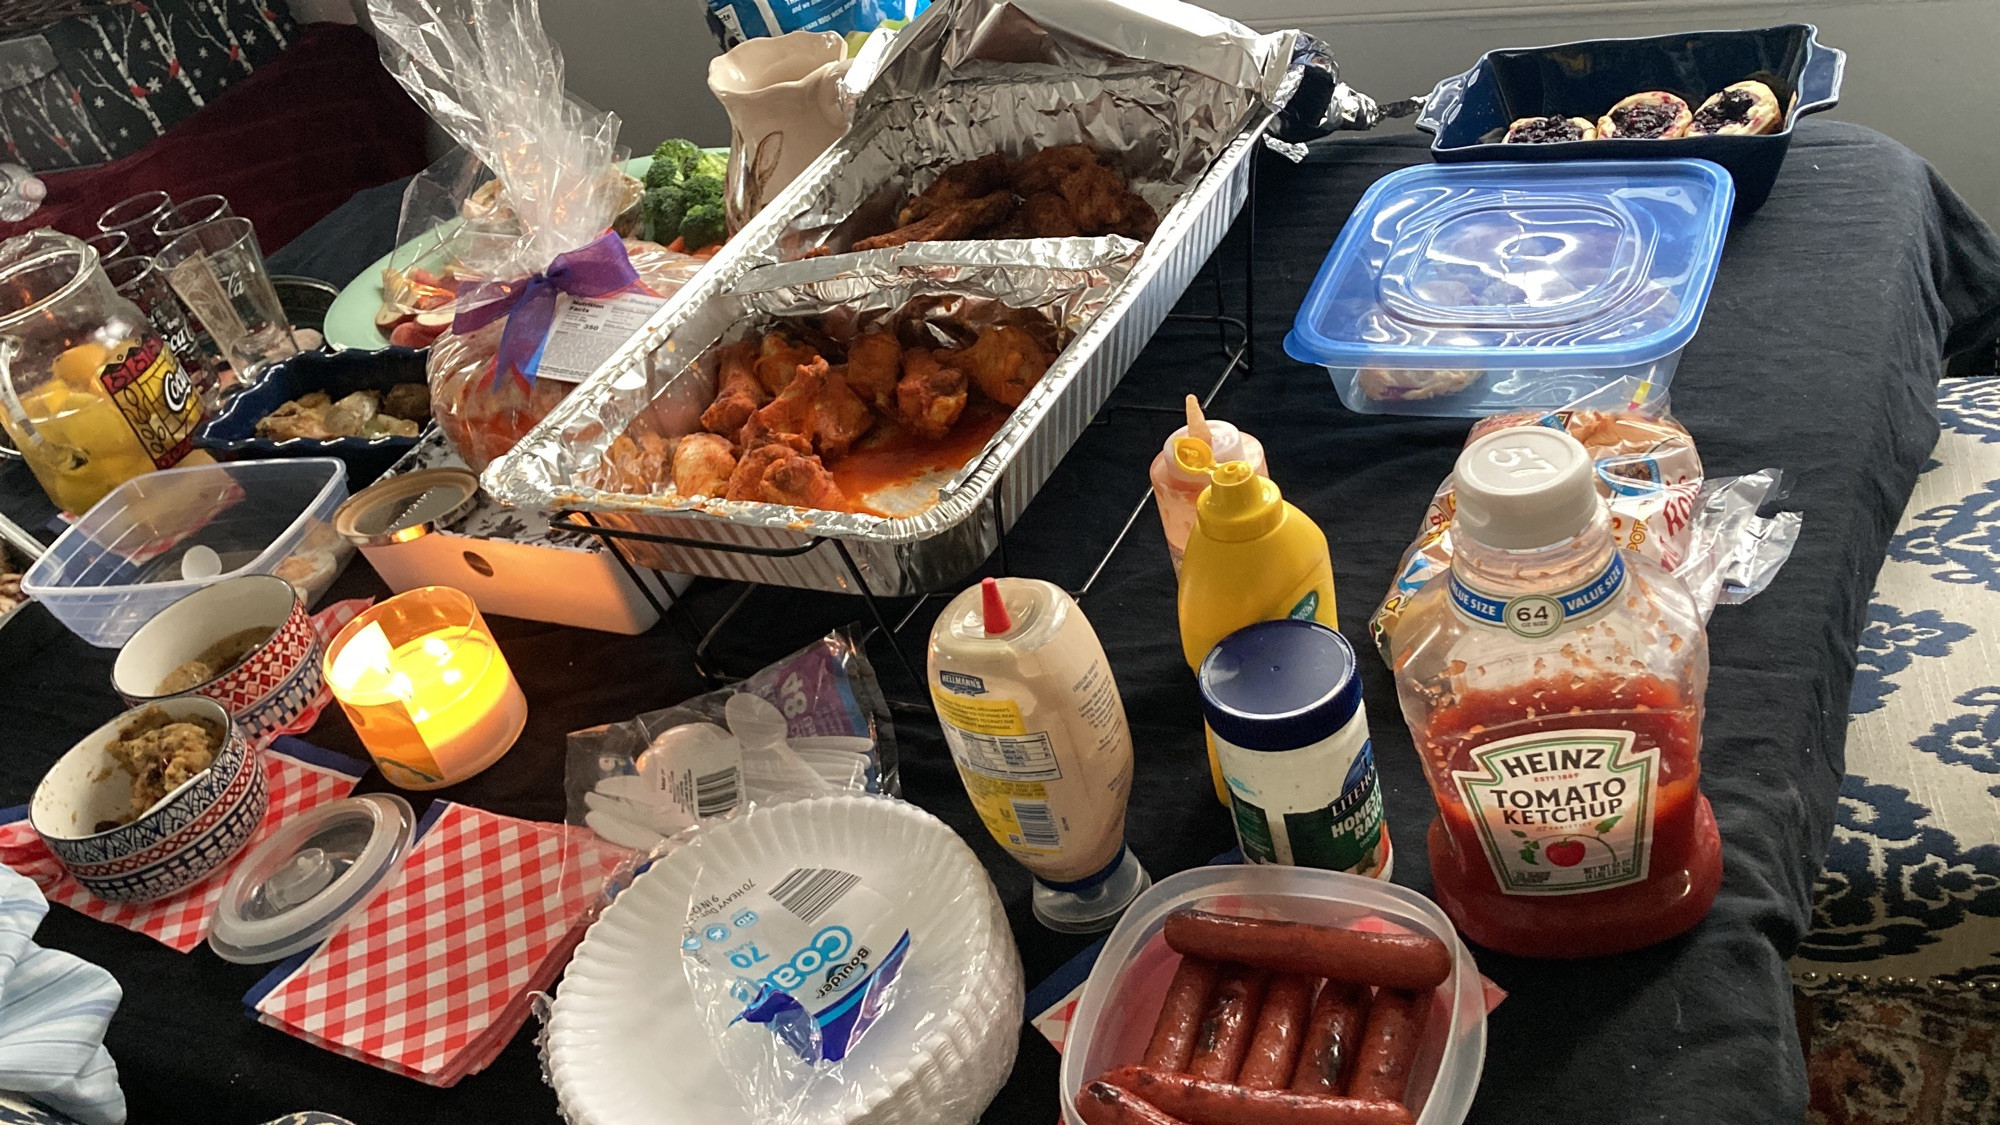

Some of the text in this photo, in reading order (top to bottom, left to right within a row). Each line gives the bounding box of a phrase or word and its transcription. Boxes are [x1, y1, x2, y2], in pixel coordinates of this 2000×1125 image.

[568, 305, 590, 314] Facts
[572, 300, 605, 310] Nutrition
[1566, 564, 1623, 611] VALUE SIZE
[1470, 598, 1497, 617] SIZE
[1516, 605, 1549, 622] 64
[941, 673, 982, 689] HELLMANN'S
[1500, 748, 1606, 778] HEINZ
[1557, 772, 1580, 781] 1869
[1331, 764, 1375, 818] LITEHO
[1489, 777, 1627, 809] TOMATO
[1503, 798, 1624, 826] KETCHUP
[742, 878, 757, 891] 70
[700, 897, 713, 910] IN
[711, 894, 720, 904] 9
[718, 886, 745, 911] HEAVY
[734, 911, 757, 927] HD
[729, 943, 770, 970] 70
[816, 946, 873, 999] Boulder
